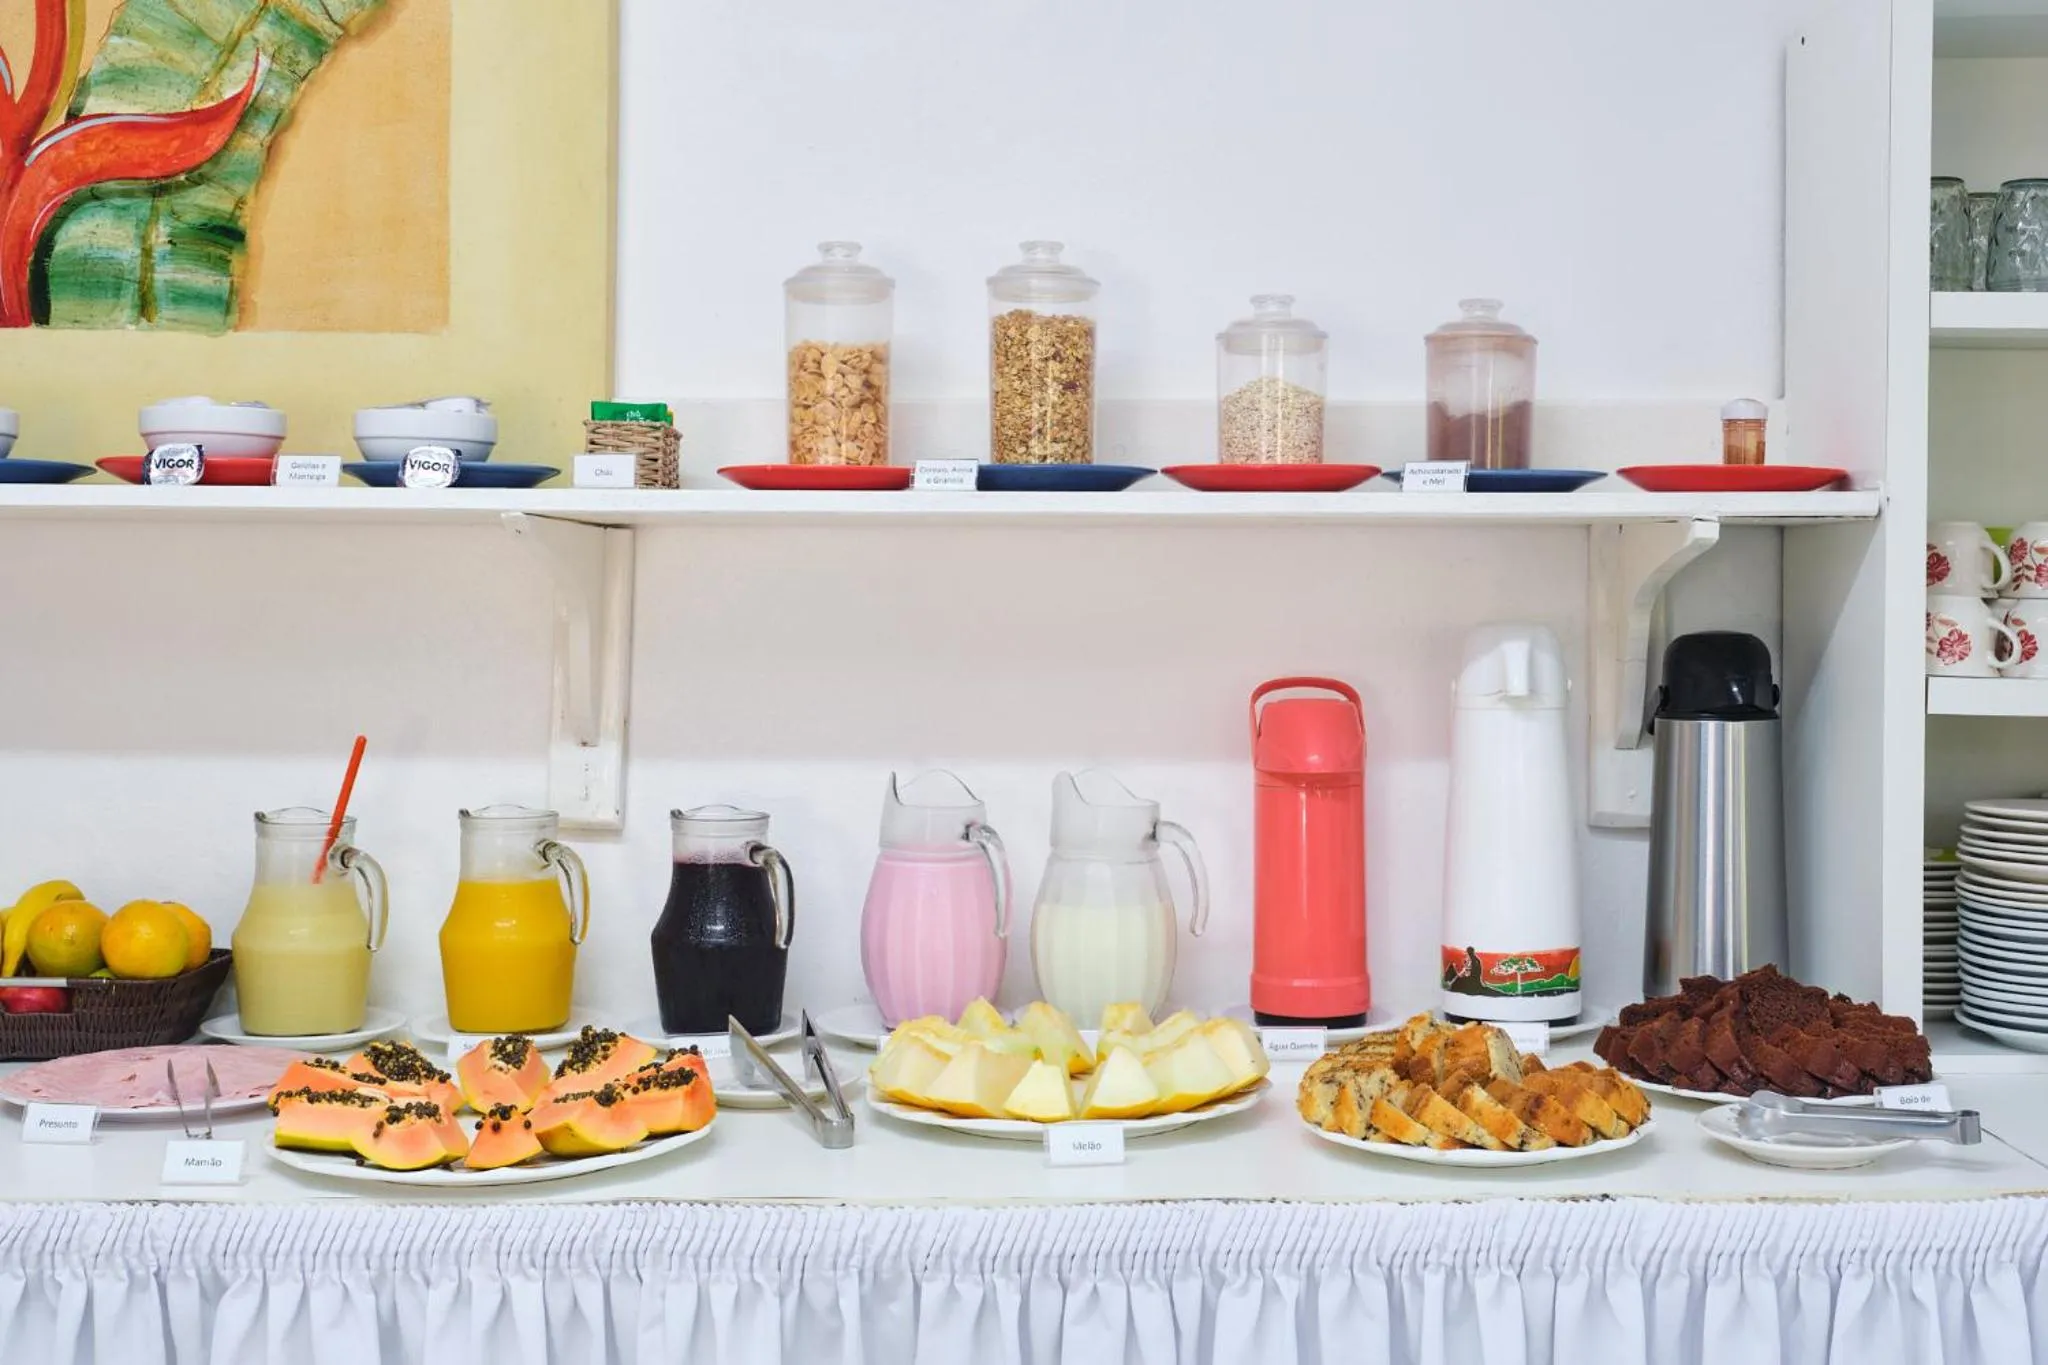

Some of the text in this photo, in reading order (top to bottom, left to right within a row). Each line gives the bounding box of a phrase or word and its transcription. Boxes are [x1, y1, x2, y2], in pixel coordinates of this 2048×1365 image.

[153, 458, 194, 470] VIGOR
[409, 459, 451, 473] VIGOR
[39, 1119, 79, 1129] Presunto
[1072, 1141, 1102, 1151] Melão
[184, 1157, 223, 1167] Mamão
